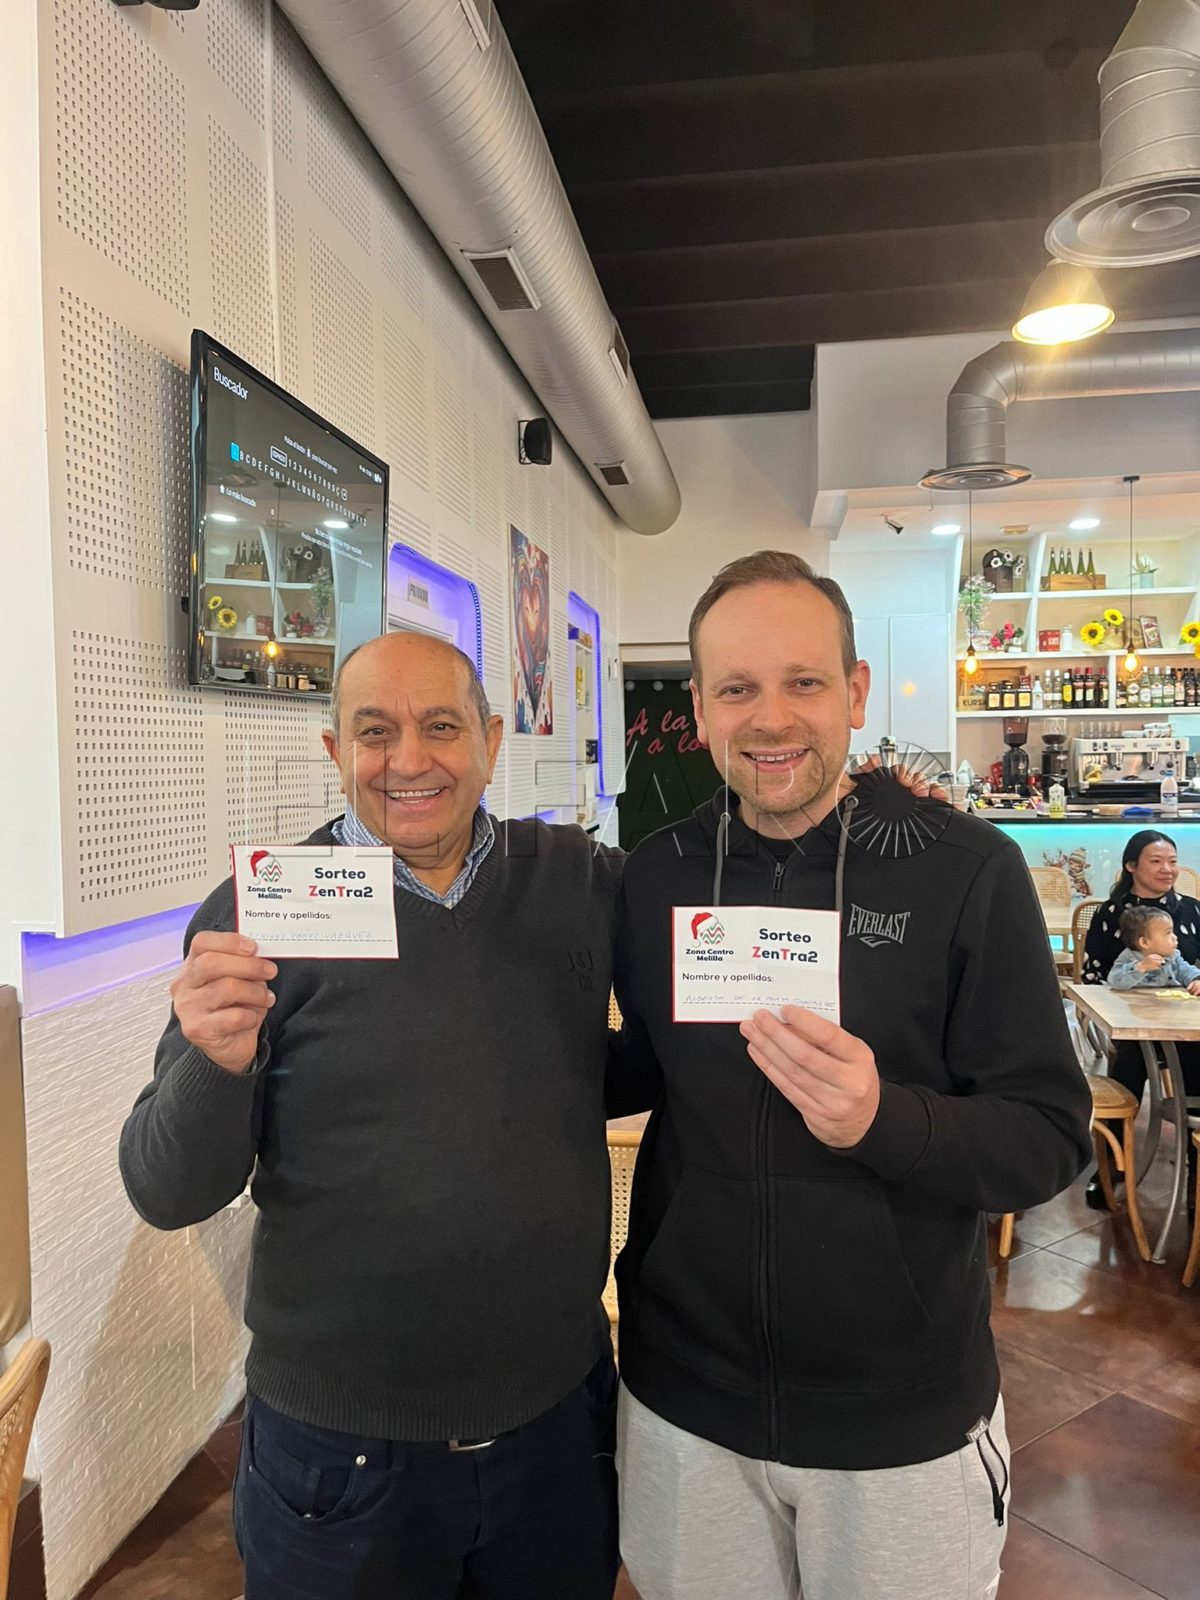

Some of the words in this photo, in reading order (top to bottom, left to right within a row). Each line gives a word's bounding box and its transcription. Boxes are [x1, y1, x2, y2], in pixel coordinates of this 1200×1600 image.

[213, 367, 249, 400] Buscador
[626, 707, 649, 747] A
[661, 710, 689, 733] la
[647, 738, 665, 755] a
[315, 867, 366, 879] Sorteo
[309, 886, 374, 898] ZenTra2
[246, 910, 280, 918] Nombre
[290, 911, 333, 920] apellidos:
[847, 903, 911, 944] EVERLAST
[759, 928, 812, 943] Sorteo
[752, 947, 818, 963] ZenTra2
[682, 973, 720, 981] Nombre
[723, 975, 728, 983] y
[731, 974, 774, 983] apellidos:
